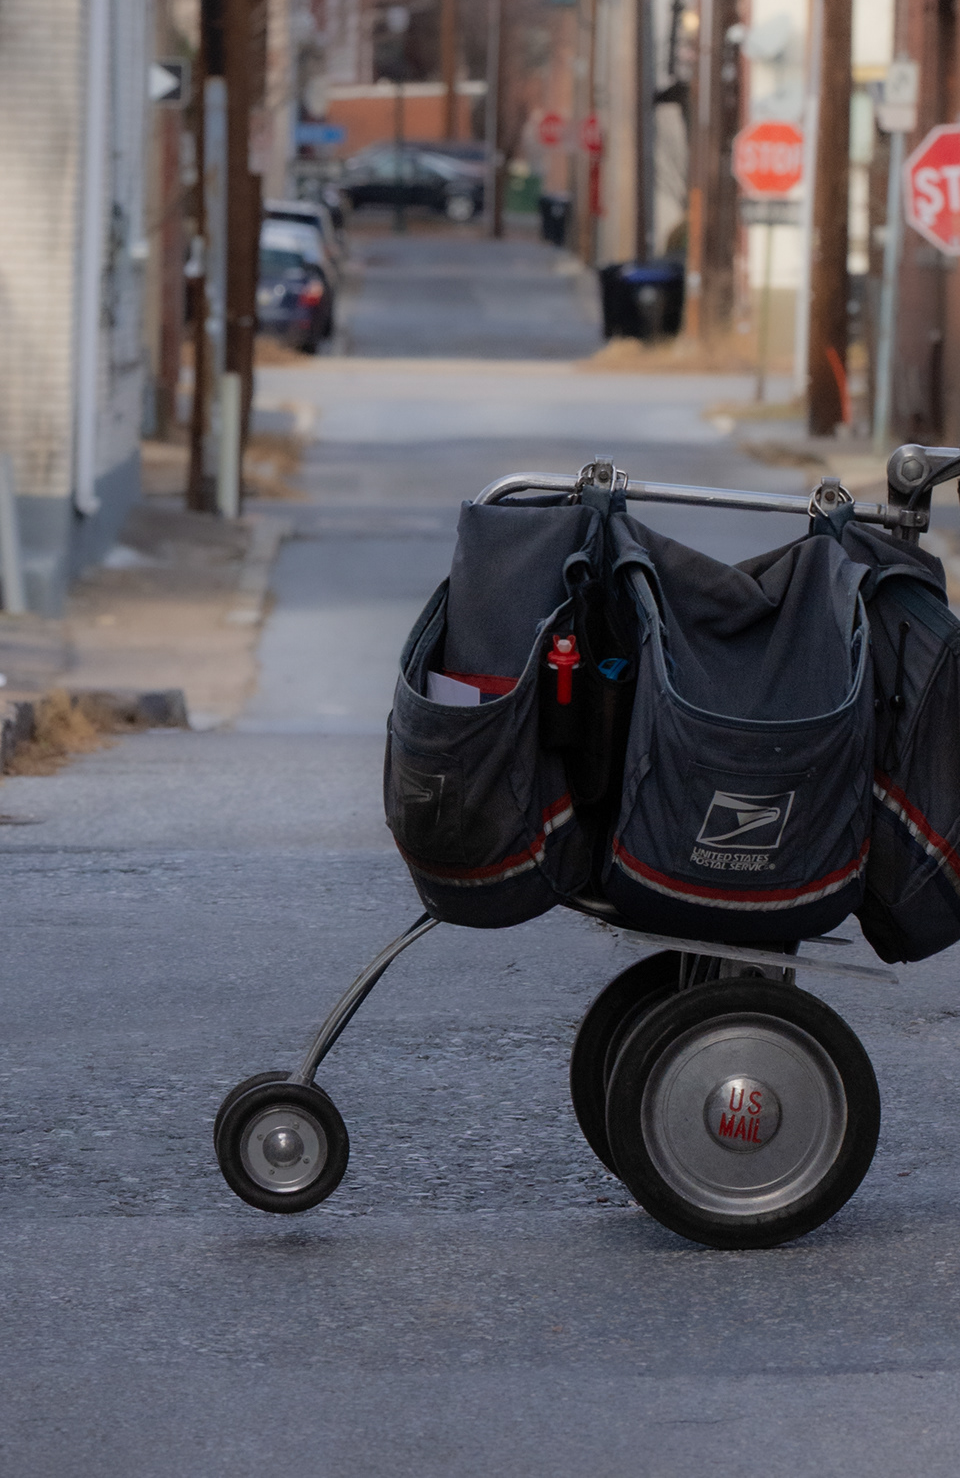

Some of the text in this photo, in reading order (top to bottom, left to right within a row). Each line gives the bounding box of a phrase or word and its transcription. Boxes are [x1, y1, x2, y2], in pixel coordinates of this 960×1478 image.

[689, 853, 727, 871] POSTAL
[693, 846, 770, 863] UNITED STATES
[729, 1087, 763, 1116] US
[718, 1112, 763, 1144] MAIL
